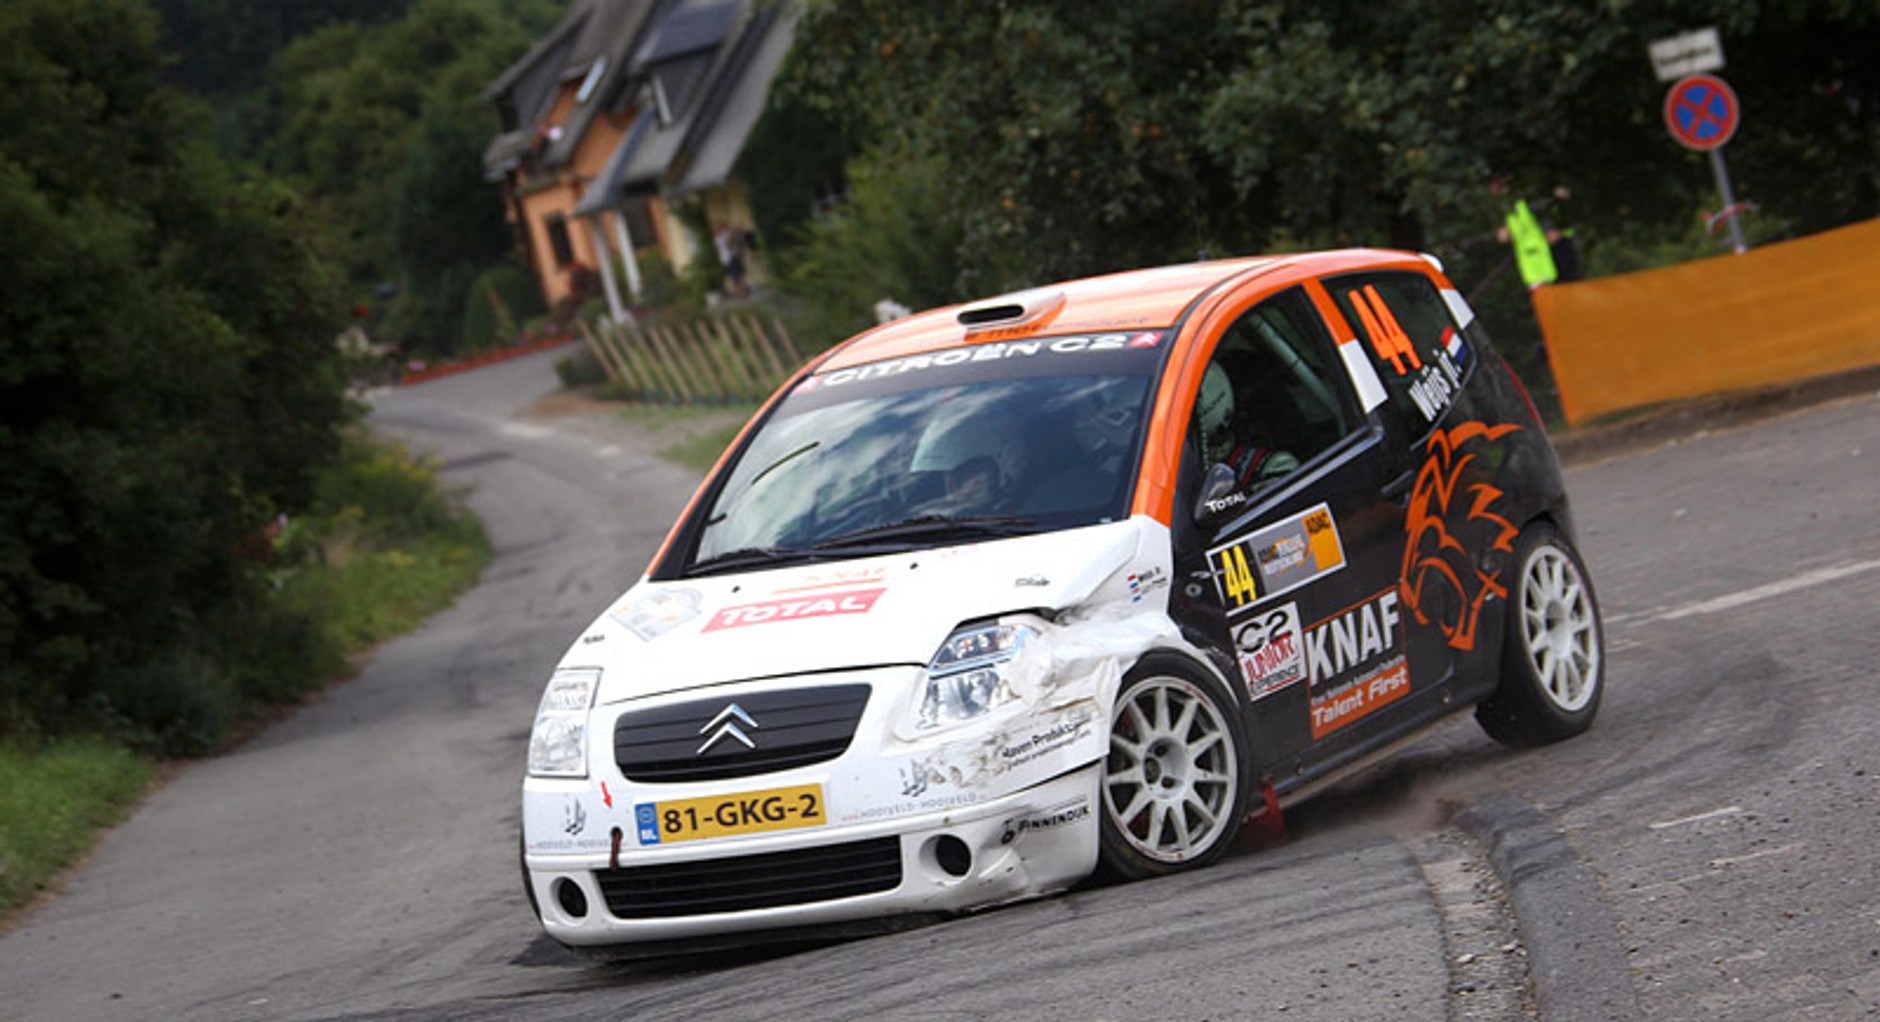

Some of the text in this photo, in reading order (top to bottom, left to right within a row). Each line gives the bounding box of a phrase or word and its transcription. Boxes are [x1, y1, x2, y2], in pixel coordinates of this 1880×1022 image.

[1050, 332, 1127, 353] C2
[1348, 284, 1422, 375] 44
[1205, 491, 1246, 513] TOTAL
[1222, 545, 1257, 606] 44
[721, 596, 867, 627] TOTAL
[1236, 610, 1293, 653] C2
[1305, 590, 1400, 687] KNAF
[1312, 688, 1364, 728] Talent
[1368, 667, 1408, 702] First
[663, 793, 820, 833] 81-GKG-2
